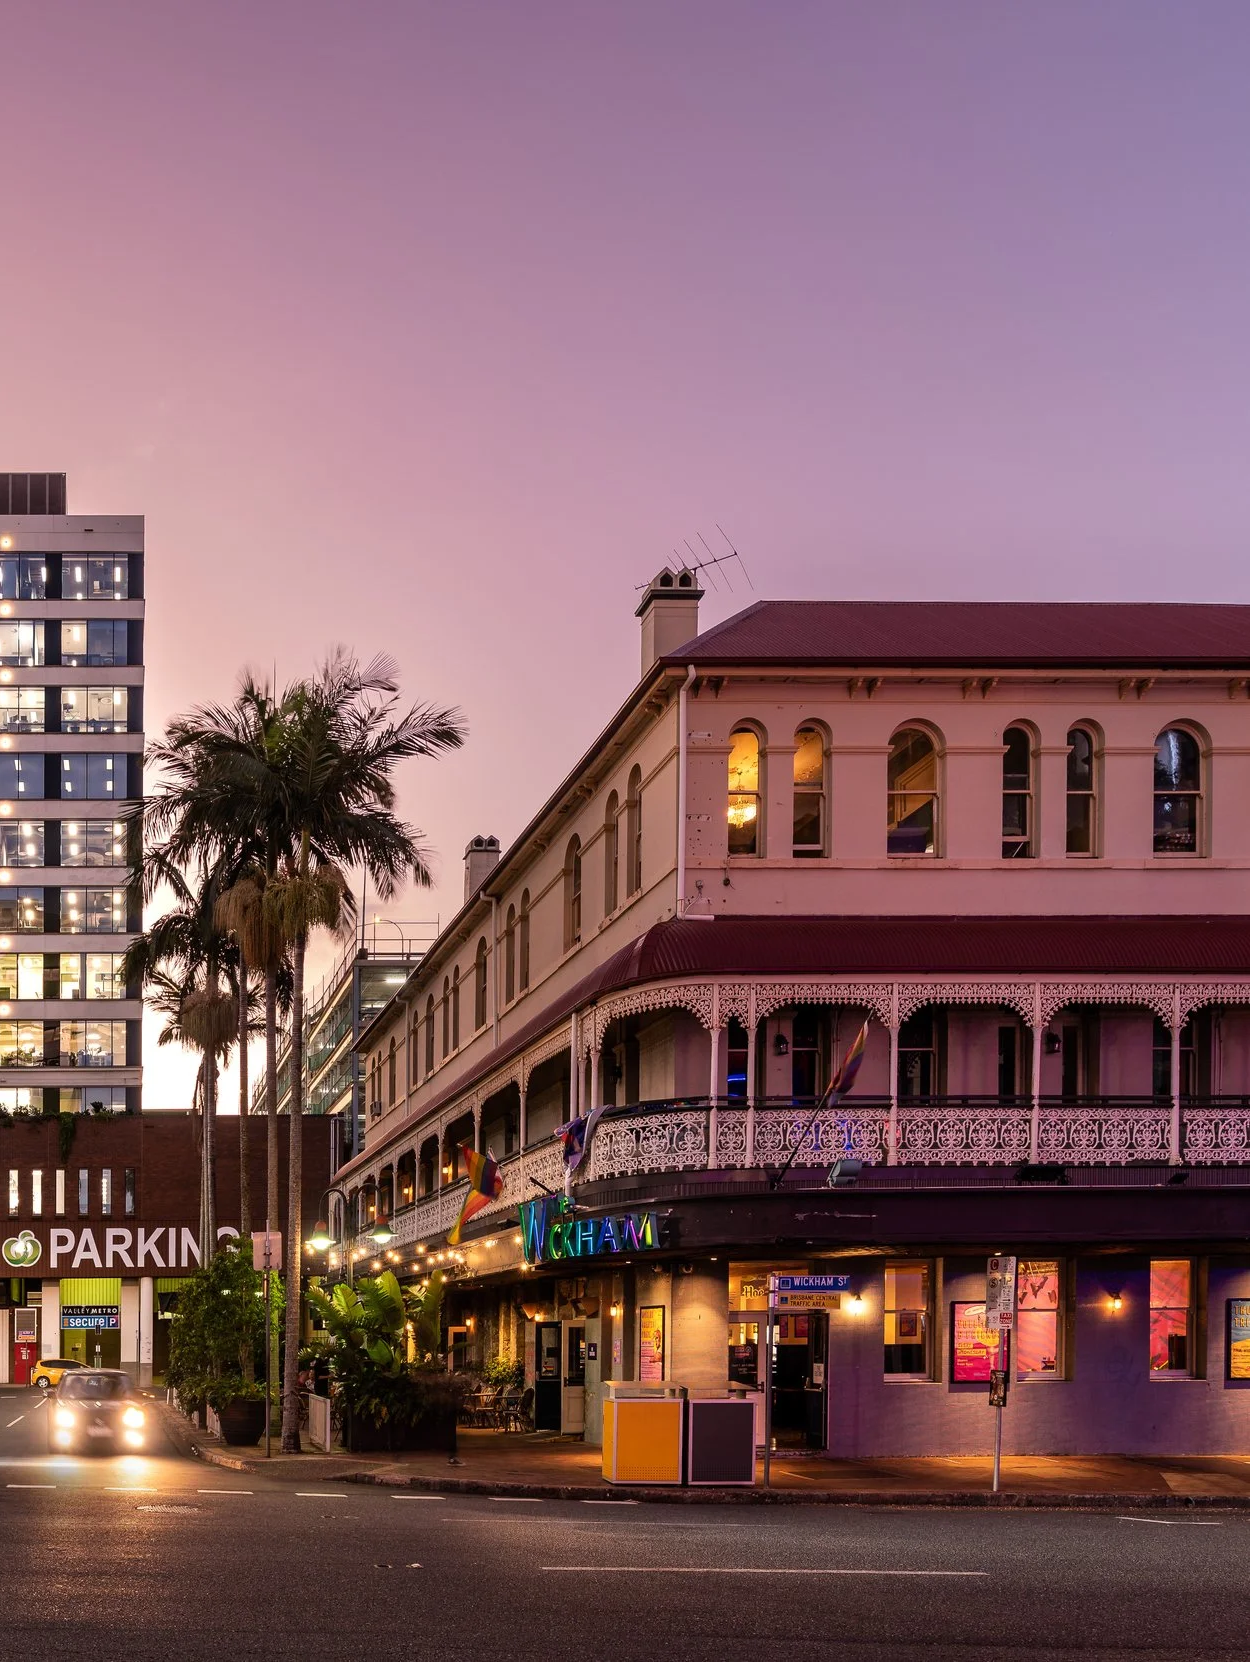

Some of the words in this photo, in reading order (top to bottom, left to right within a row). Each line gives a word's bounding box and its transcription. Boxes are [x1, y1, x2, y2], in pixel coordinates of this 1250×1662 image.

[518, 1197, 661, 1266] WICKHAM
[793, 1277, 834, 1287] WICKHAM
[838, 1277, 847, 1286] ST
[69, 1317, 105, 1327] secure
